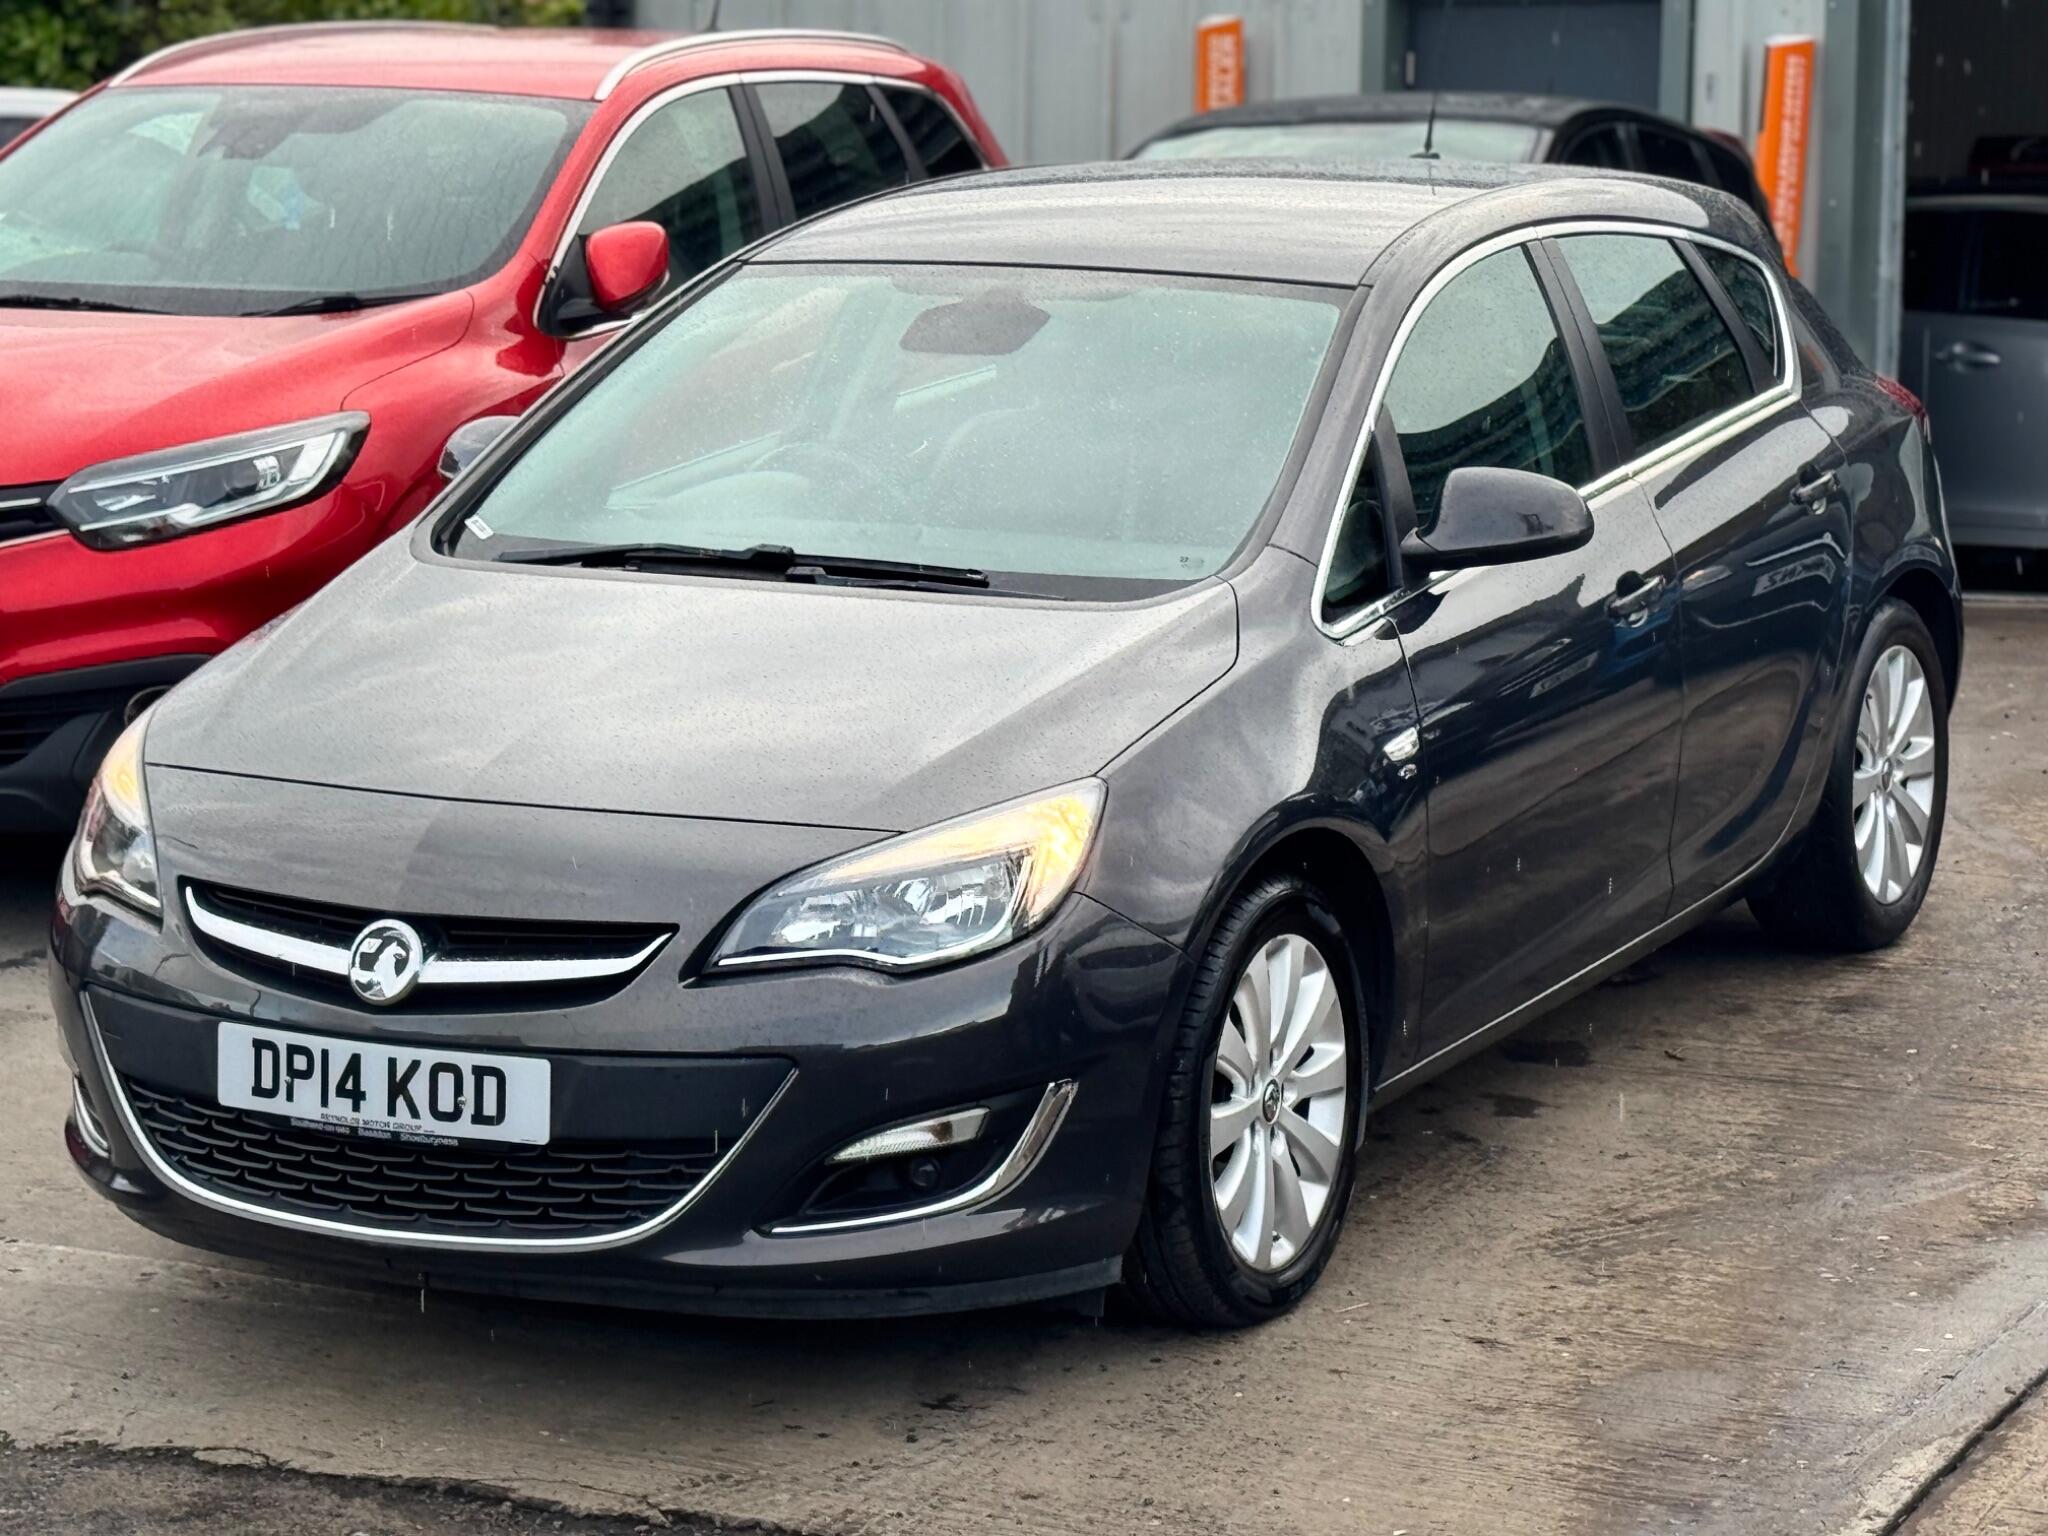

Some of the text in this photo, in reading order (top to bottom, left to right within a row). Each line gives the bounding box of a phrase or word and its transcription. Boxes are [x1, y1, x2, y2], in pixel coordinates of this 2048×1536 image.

[252, 1037, 507, 1127] DP14 KOD
[362, 1118, 391, 1128] MOTOR
[393, 1122, 423, 1132] GROUP
